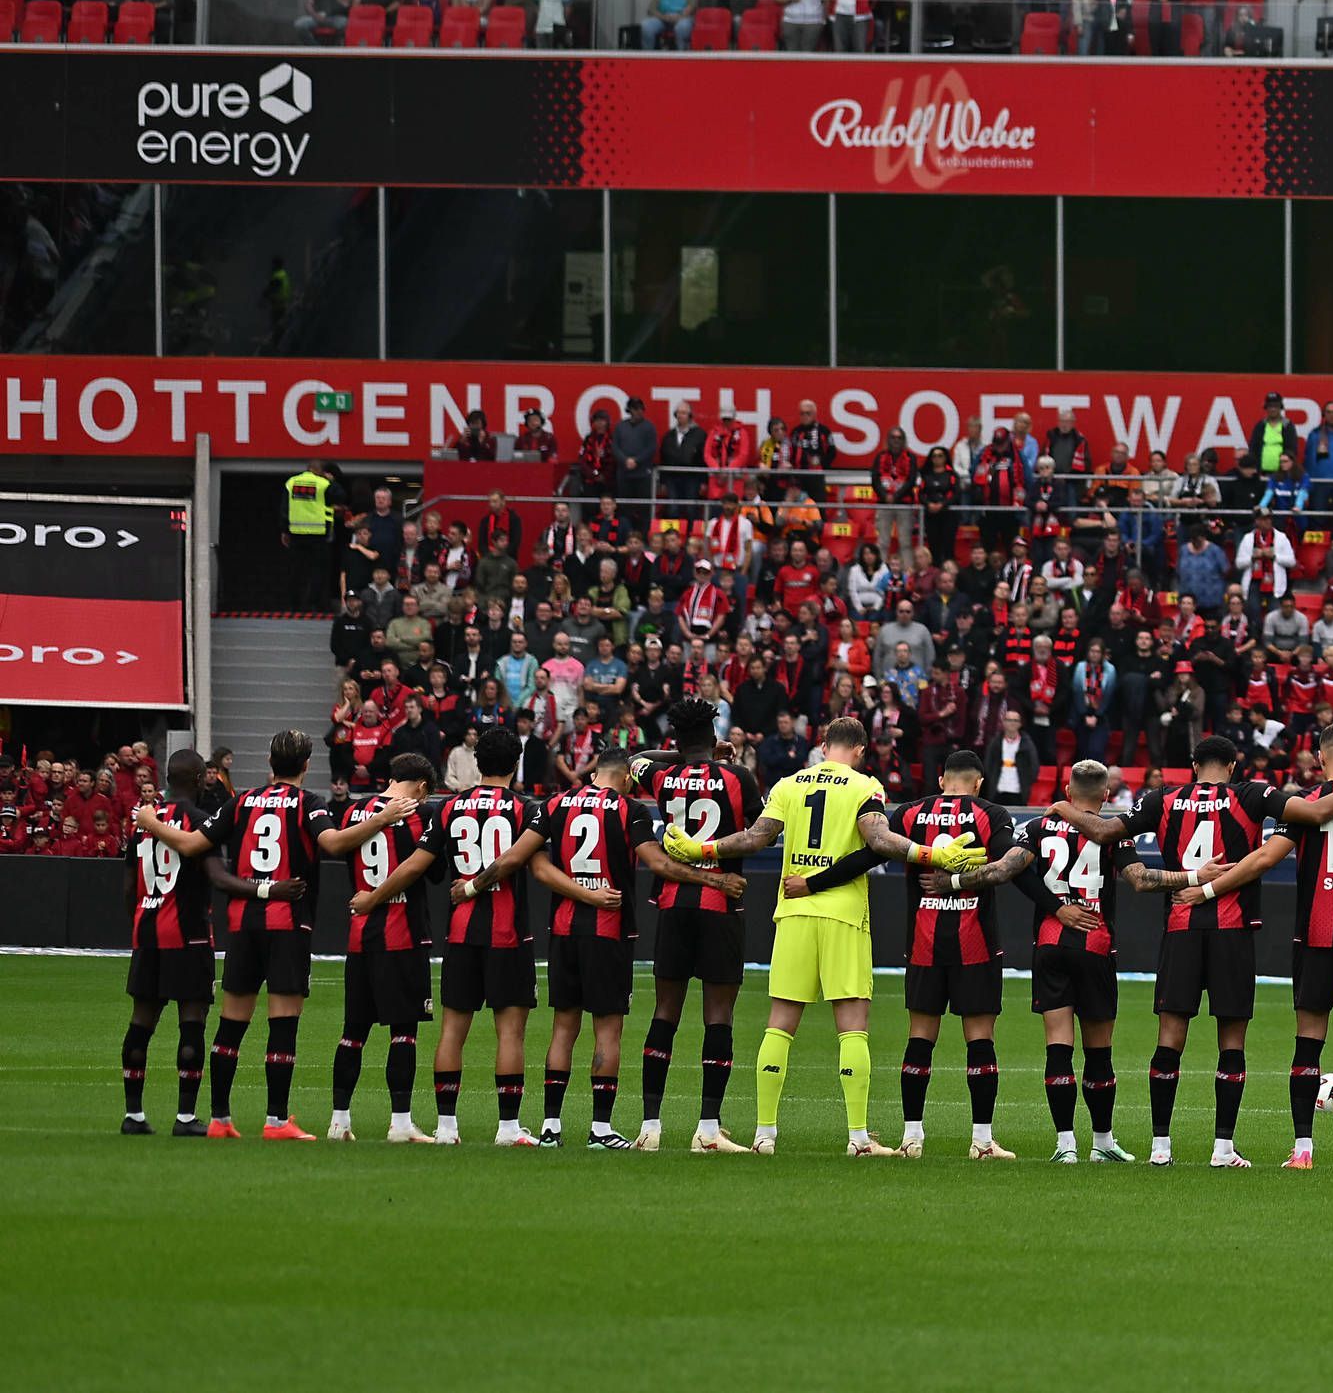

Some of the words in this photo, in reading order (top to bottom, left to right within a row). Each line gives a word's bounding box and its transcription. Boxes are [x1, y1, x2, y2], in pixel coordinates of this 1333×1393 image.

[137, 80, 249, 127] pure
[137, 129, 310, 177] energy
[809, 97, 937, 167] Rudolf
[937, 97, 1036, 152] Weber
[244, 796, 282, 808] BAYER
[282, 796, 299, 809] 04
[454, 798, 495, 811] BAYER
[497, 799, 513, 811] 04
[561, 796, 600, 809] BAYER
[602, 798, 618, 811] 04
[664, 777, 705, 791] BAYER
[707, 778, 724, 791] 04
[833, 776, 849, 786] 04
[1173, 797, 1214, 812] BAYER
[1214, 797, 1231, 811] 04
[250, 813, 282, 872] 3
[666, 796, 721, 842] 12
[805, 789, 827, 850] 1
[917, 812, 955, 827] BAYER
[958, 812, 975, 825] 04
[1045, 819, 1079, 833] BAYE
[137, 838, 181, 896] 19
[361, 831, 389, 888] 9
[450, 815, 512, 876] 30
[568, 813, 601, 874] 2
[1182, 820, 1223, 871] 4
[1041, 836, 1104, 900] 24
[919, 895, 979, 911] FERNÁNDEZ
